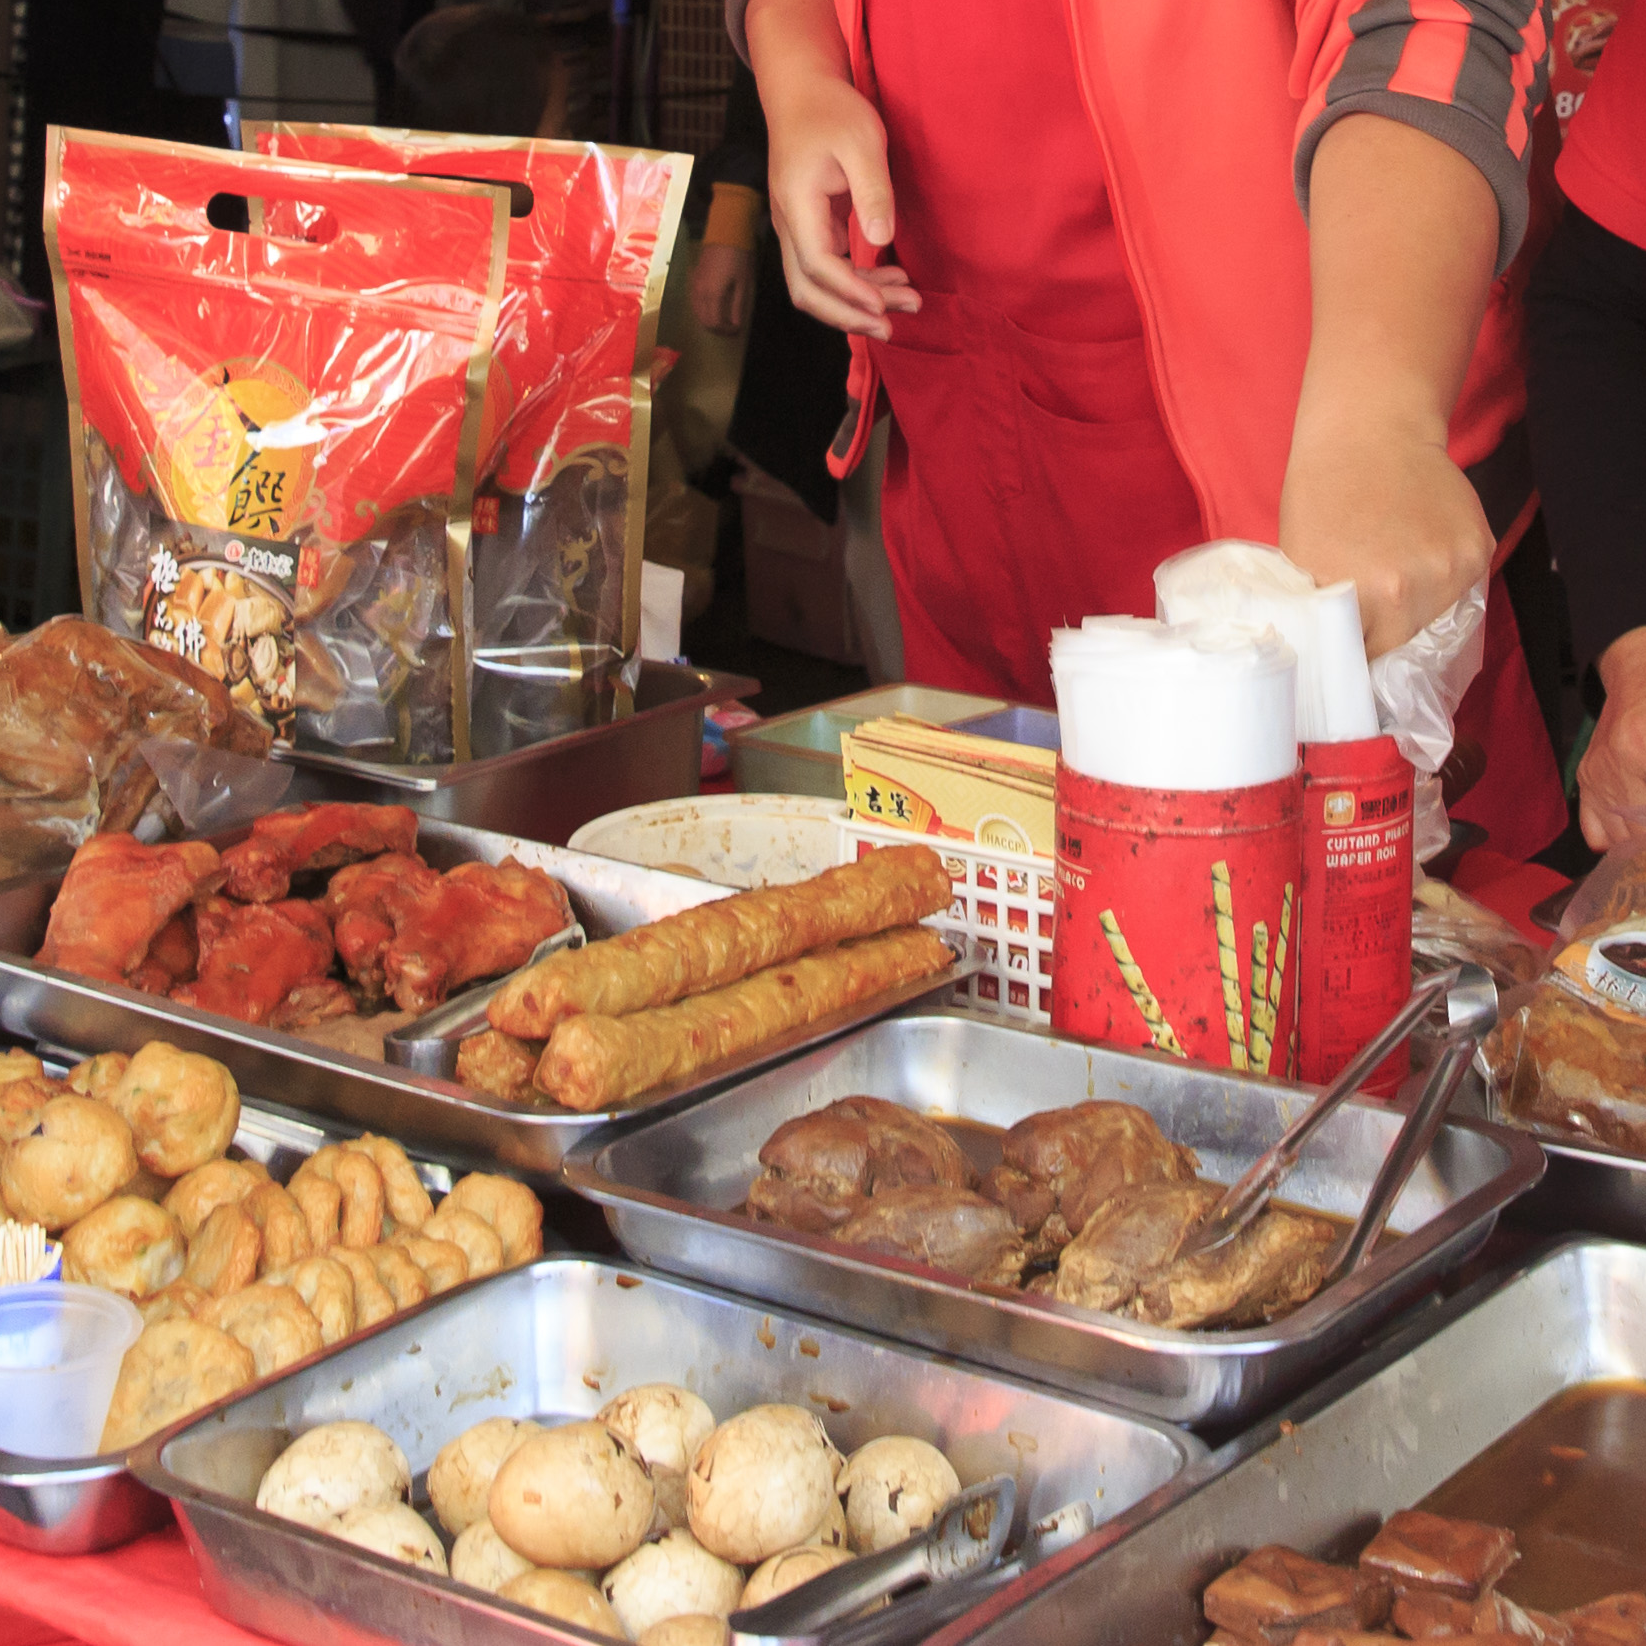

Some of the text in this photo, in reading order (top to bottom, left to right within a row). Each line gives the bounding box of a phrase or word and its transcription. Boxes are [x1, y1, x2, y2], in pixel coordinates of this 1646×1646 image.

[853, 784, 913, 823] 吉宴
[986, 832, 1023, 854] HACCP
[1326, 833, 1380, 852] CUSTARD
